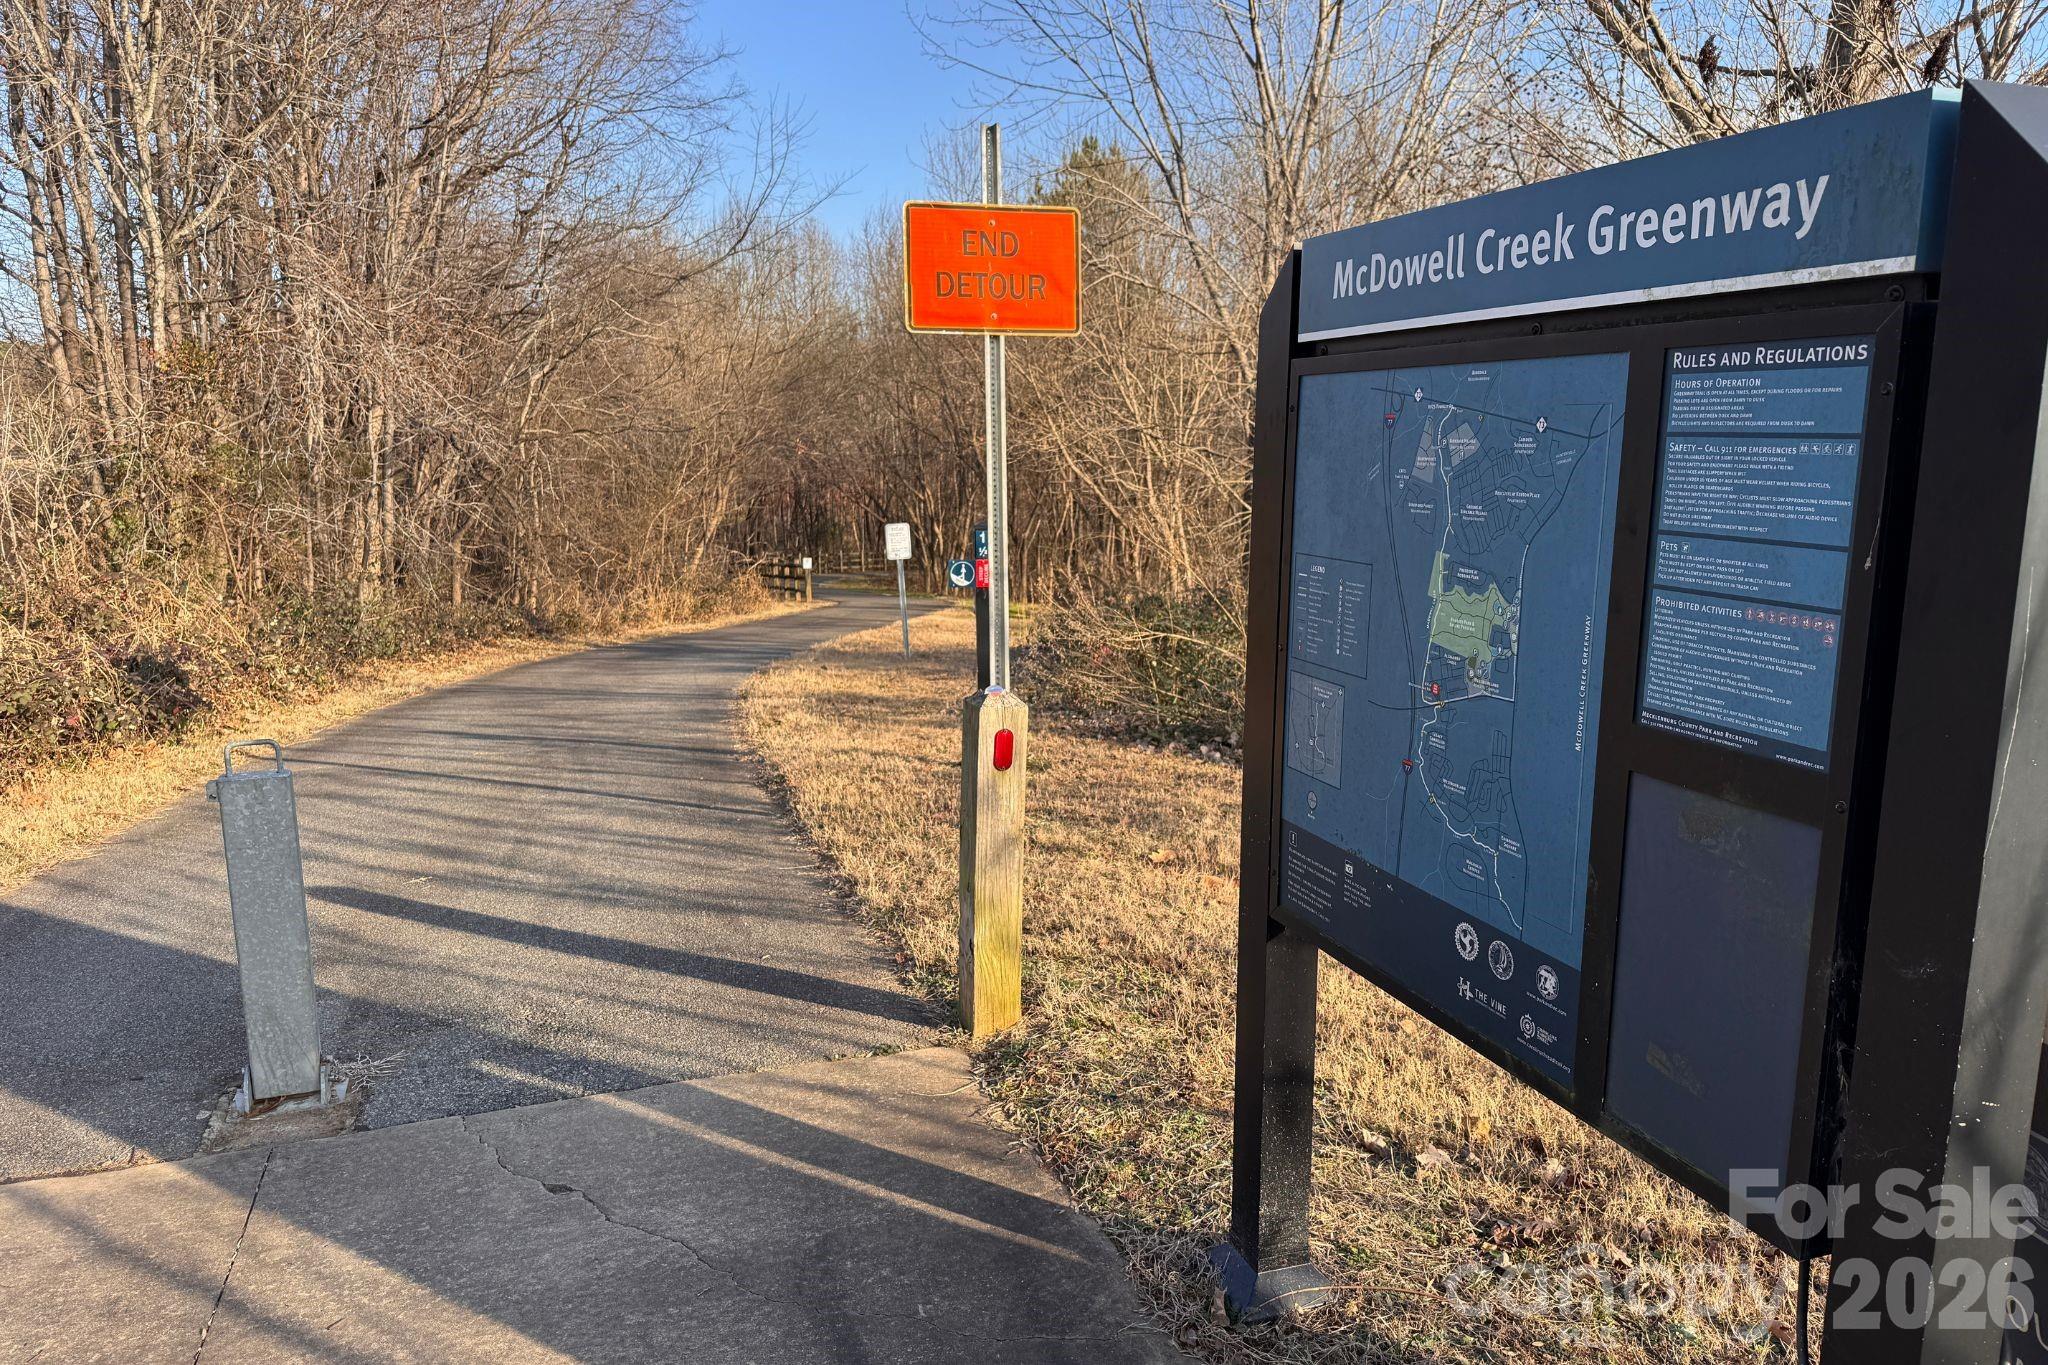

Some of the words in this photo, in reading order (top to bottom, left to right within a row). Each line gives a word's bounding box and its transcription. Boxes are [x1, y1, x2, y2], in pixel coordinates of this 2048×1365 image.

[962, 230, 1019, 257] END
[1332, 234, 1465, 300] McDowell
[1475, 212, 1575, 274] Creek
[1588, 174, 1831, 256] Greenway
[936, 271, 1046, 300] DETOUR
[1673, 350, 1716, 368] RULES
[1720, 351, 1750, 366] AND
[1754, 344, 1868, 364] REGULATIONS
[1715, 376, 1761, 387] OPERATION
[1669, 442, 1696, 451] SAFETY
[1704, 444, 1719, 452] CALL
[1720, 446, 1732, 454] 911
[1660, 540, 1678, 551] PETS
[1655, 596, 1699, 611] PROHIBITED
[1701, 604, 1742, 618] ACTIVITIES
[1474, 987, 1488, 1004] THE
[1490, 997, 1506, 1015] VINE
